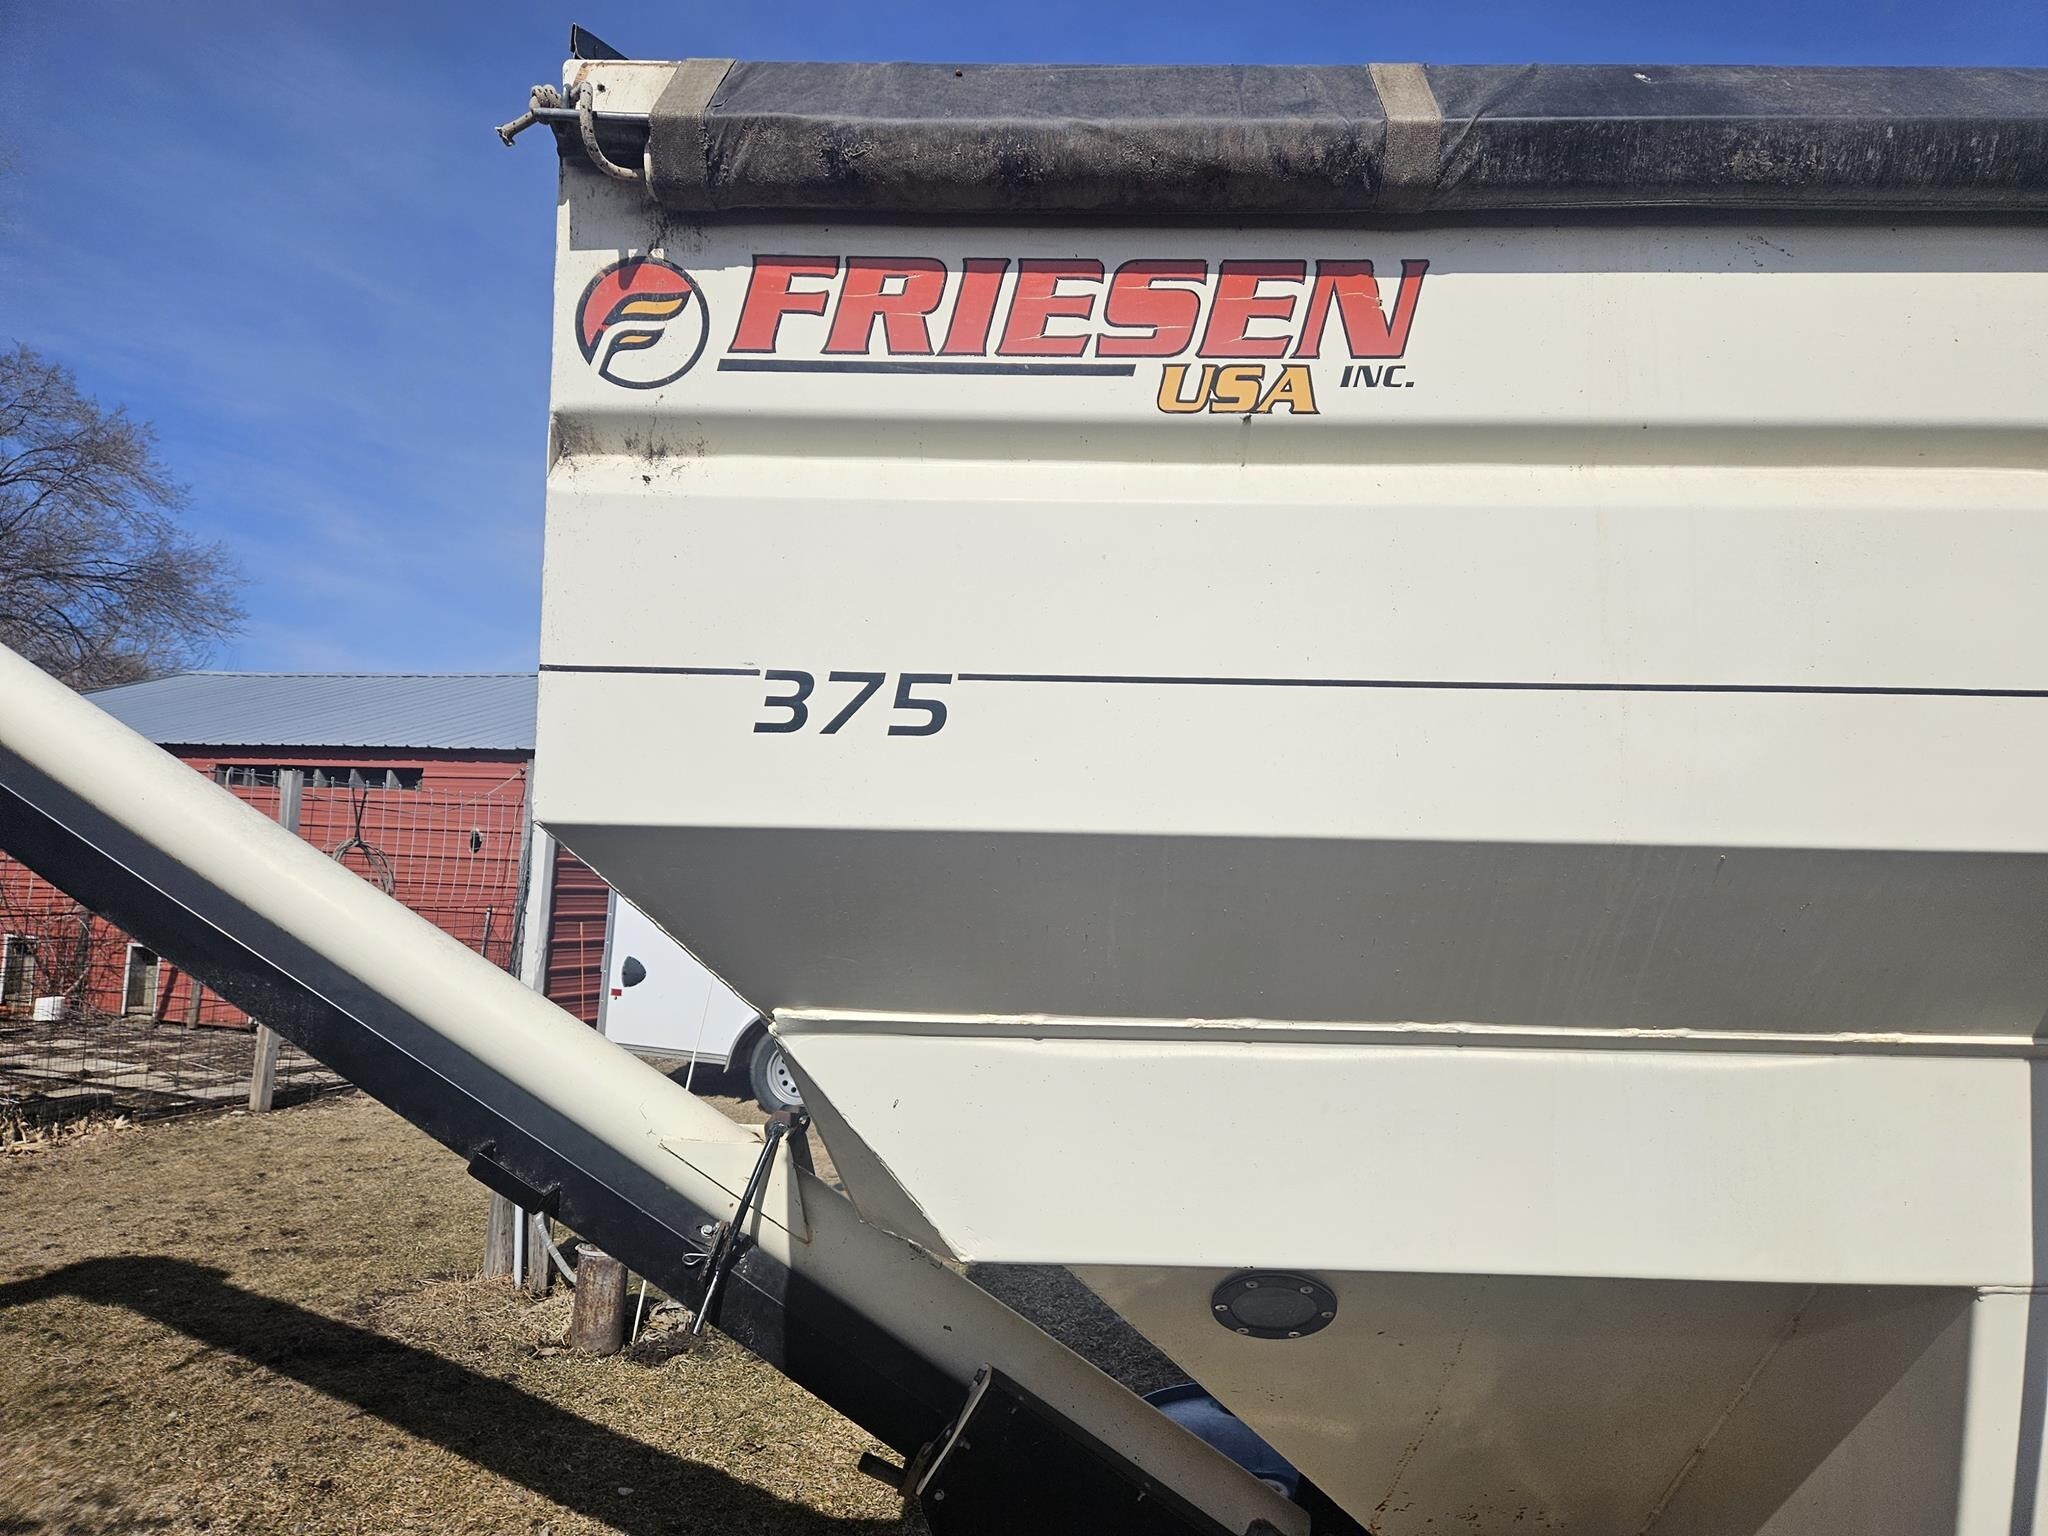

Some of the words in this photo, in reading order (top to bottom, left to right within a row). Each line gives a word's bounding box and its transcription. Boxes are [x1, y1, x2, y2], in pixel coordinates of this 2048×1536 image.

[727, 255, 1430, 359] FRIESEN
[1157, 364, 1320, 415] USA
[1340, 365, 1415, 388] INC.
[753, 669, 953, 736] 375
